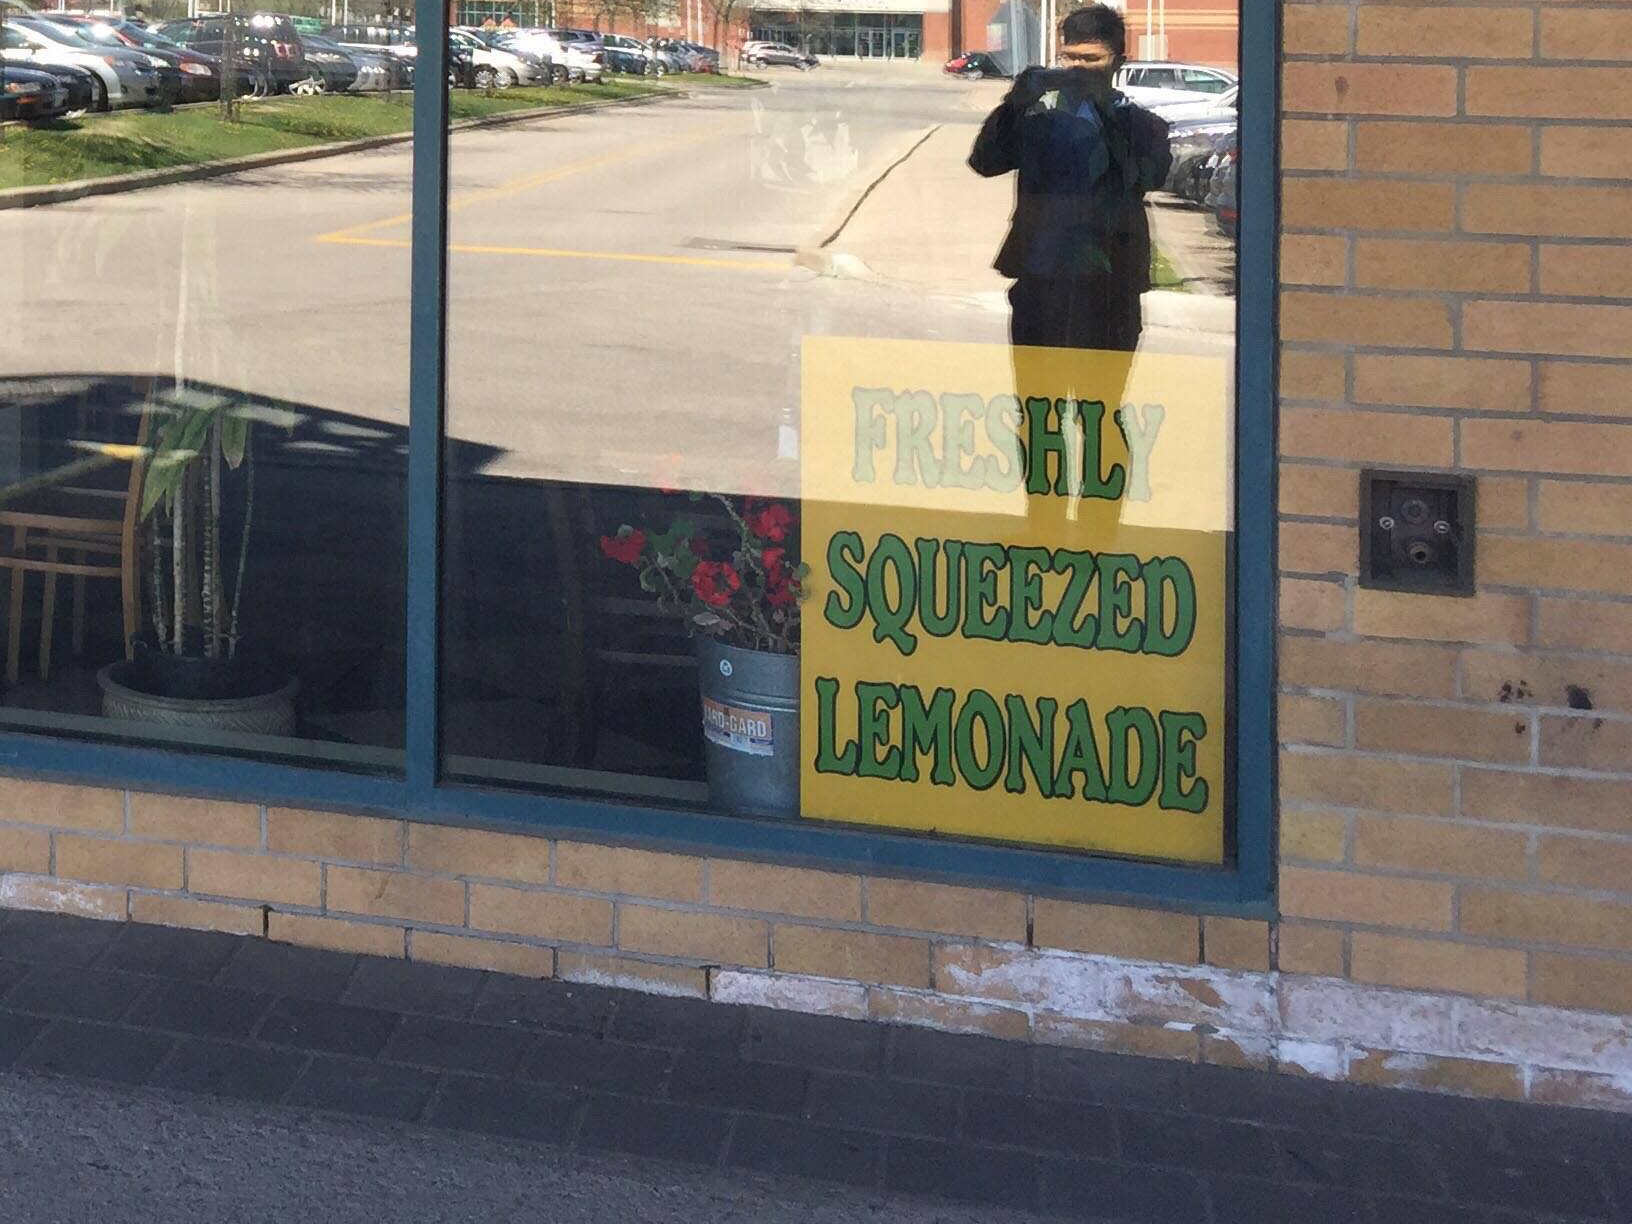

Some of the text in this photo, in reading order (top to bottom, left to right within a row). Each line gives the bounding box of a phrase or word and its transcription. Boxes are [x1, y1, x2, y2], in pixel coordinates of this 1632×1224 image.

[851, 386, 1164, 502] FRESHLY
[824, 530, 1198, 657] SQUEEZED
[814, 677, 1209, 814] LEMONADE
